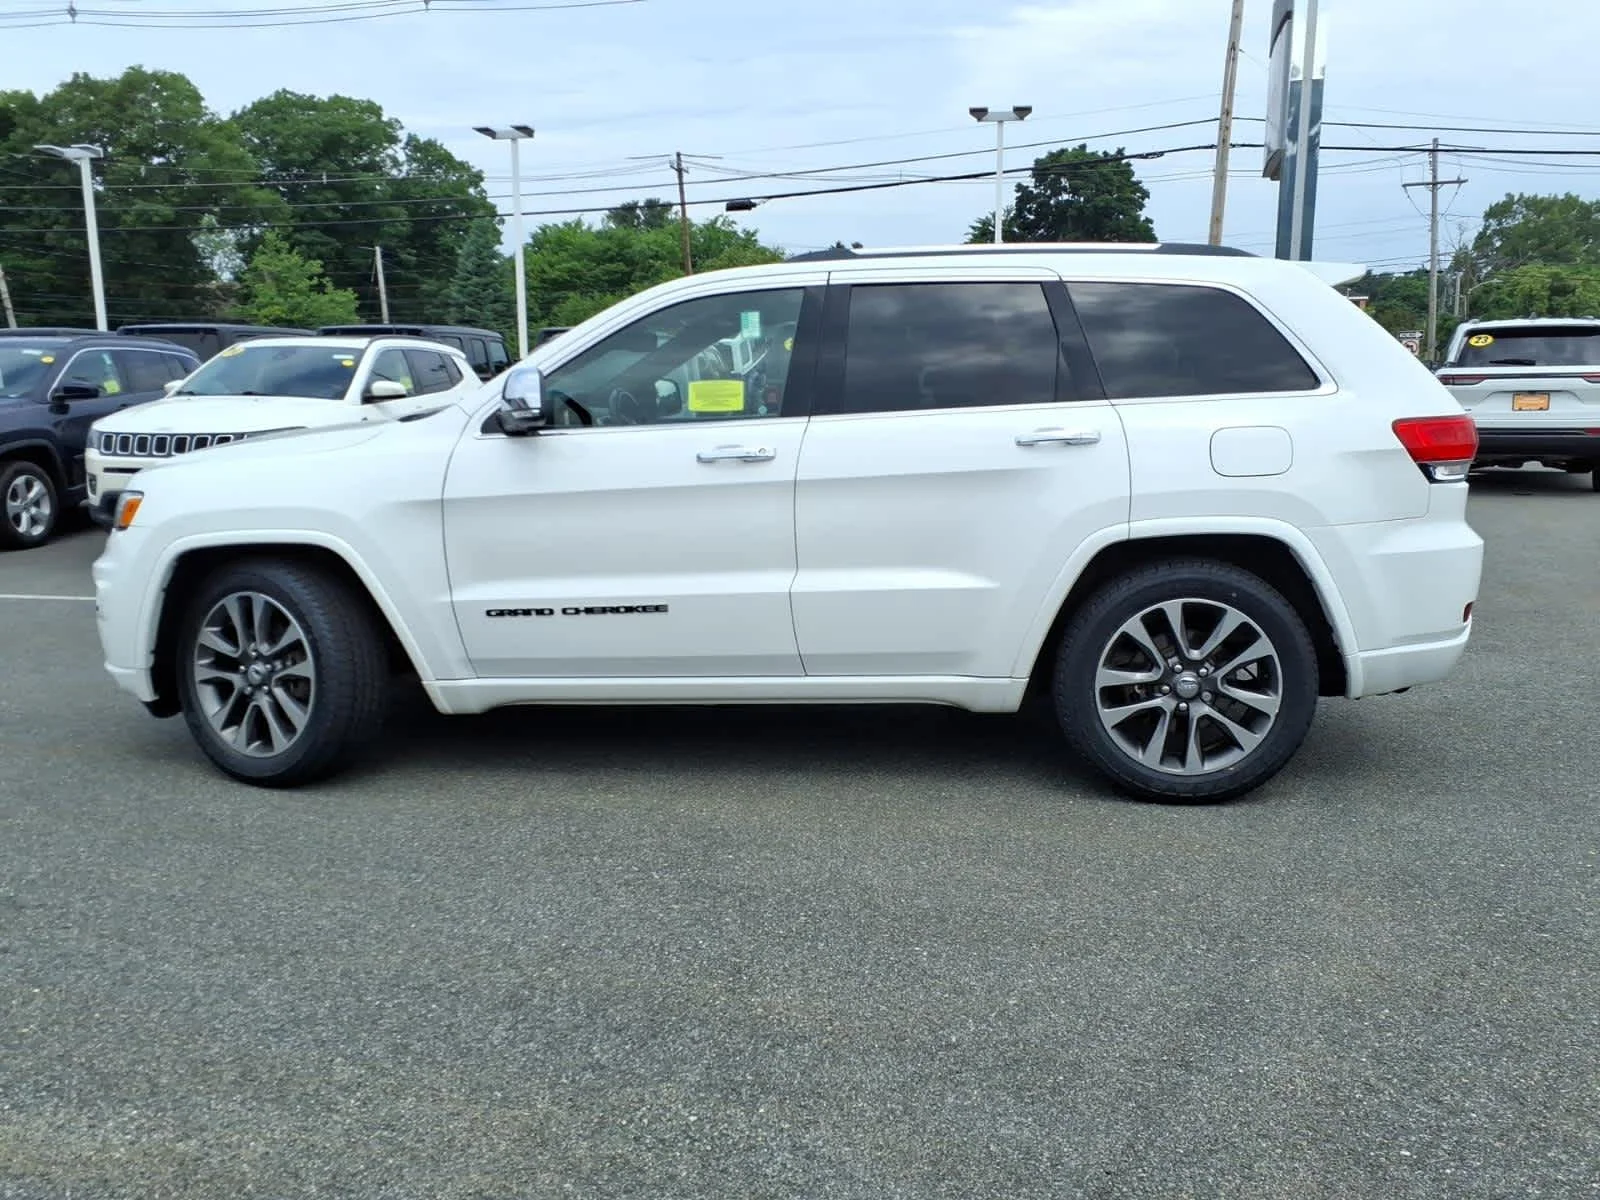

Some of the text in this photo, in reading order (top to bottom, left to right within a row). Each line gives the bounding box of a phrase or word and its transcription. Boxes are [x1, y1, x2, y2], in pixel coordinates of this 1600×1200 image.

[1474, 335, 1489, 344] 23
[485, 604, 669, 617] GRAND CHEROKEE
